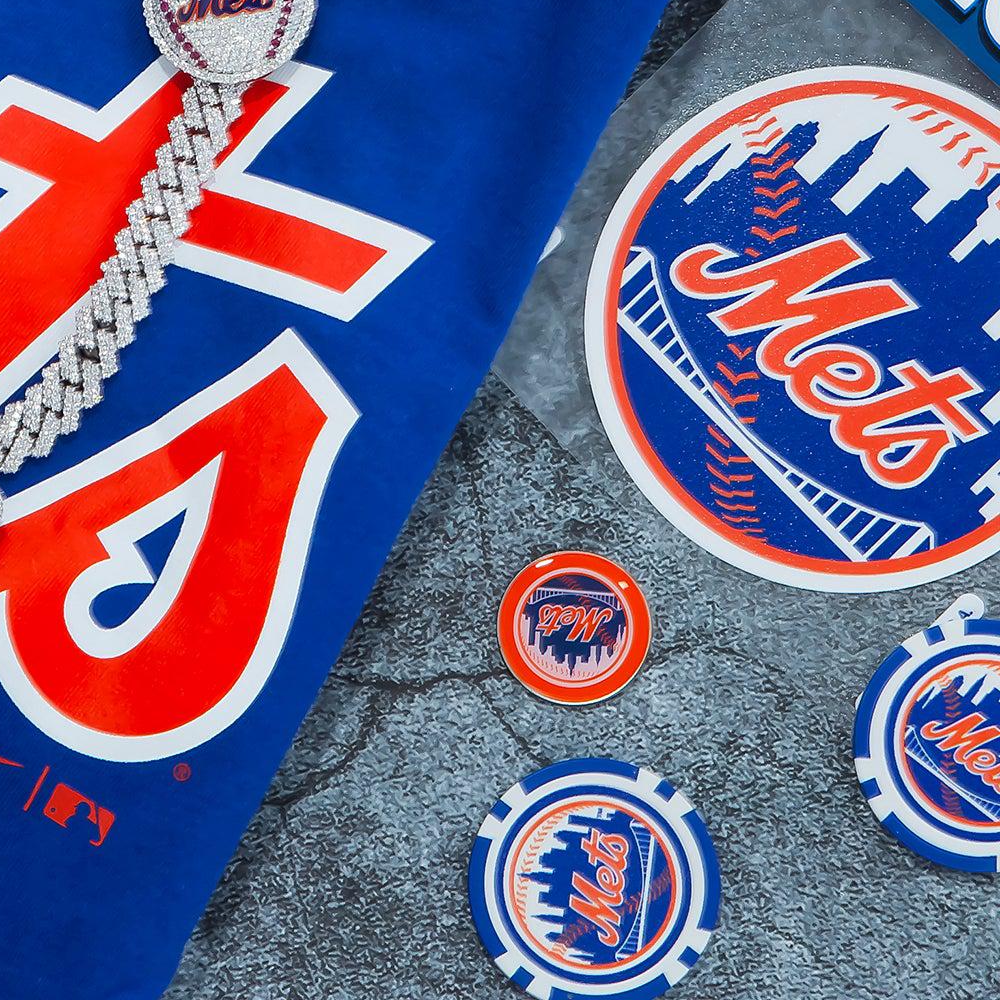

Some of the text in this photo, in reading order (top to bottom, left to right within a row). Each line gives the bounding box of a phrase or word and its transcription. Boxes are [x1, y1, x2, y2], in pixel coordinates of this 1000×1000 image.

[670, 233, 989, 489] Mets
[536, 604, 613, 642] Mets
[569, 828, 629, 947] Mets
